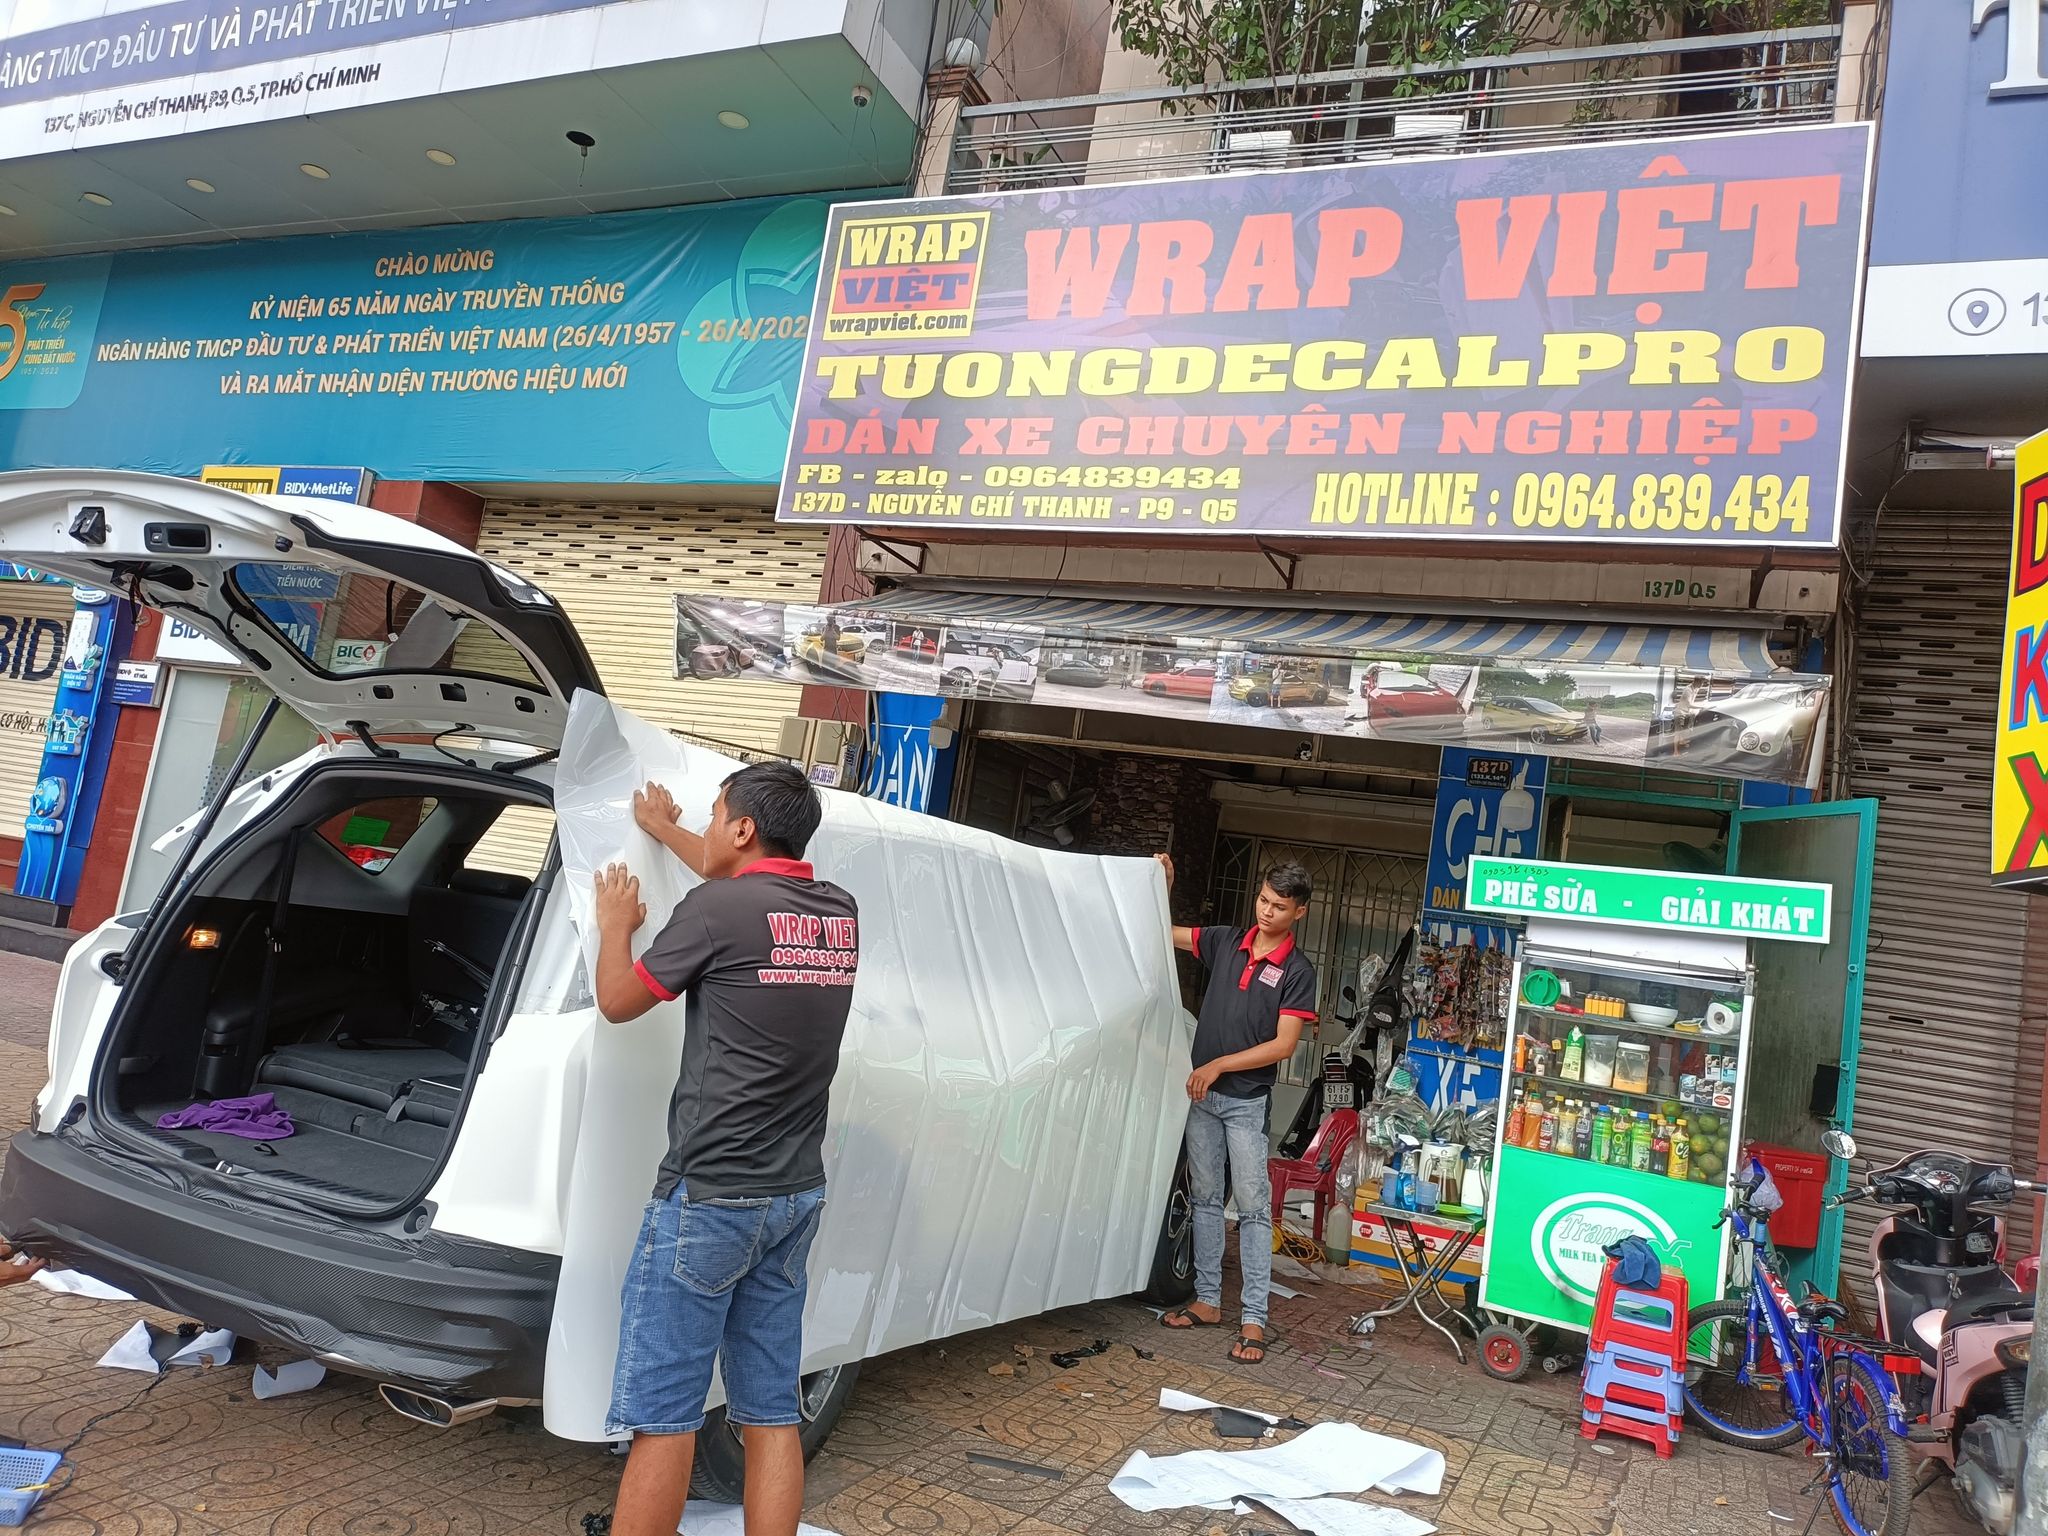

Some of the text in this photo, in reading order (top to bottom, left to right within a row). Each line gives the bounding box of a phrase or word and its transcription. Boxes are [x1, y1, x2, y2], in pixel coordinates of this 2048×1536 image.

[47, 38, 110, 80] TMCP
[112, 20, 165, 68] ĐẦU
[170, 13, 208, 58] TƯ
[210, 6, 241, 51] VÀ
[77, 99, 133, 128] NGUYỄN
[133, 96, 159, 119] CHÍ
[305, 66, 338, 92] CHÍ
[336, 63, 381, 88] MINH
[849, 221, 977, 266] WRAP
[1024, 155, 1842, 324] WRAP VIỆT
[374, 248, 494, 278] CHÀO MỪNG
[249, 276, 625, 321] KỶ NIỆM 65 NĂM NGÀY TRUYỀN THỐNG
[842, 268, 970, 310] VIỆT
[98, 339, 140, 362] NGÂN
[144, 336, 191, 361] HÀNG
[195, 337, 243, 358] TMCP
[246, 329, 284, 356] ĐẦU
[288, 334, 315, 355] TƯ
[314, 336, 328, 354] &
[332, 333, 384, 354] PHÁT
[389, 326, 444, 353] TRIỂN
[450, 323, 494, 354] VIỆT
[498, 326, 546, 350] NAM
[552, 320, 676, 352] (26/4/1957
[829, 312, 968, 335] wrapviet.com
[220, 361, 628, 398] VÀ RA MẮT NHẬN DIỆN THƯƠNG HIỆU MỚI
[816, 325, 1826, 399] TUONGDECALPRO
[802, 396, 1819, 466] DÁN XE CHUYÊN NGHIỆP
[797, 465, 843, 484] FB
[874, 466, 949, 488] zalo
[983, 466, 1242, 488] 0964839434
[792, 493, 846, 513] 137D
[867, 487, 963, 516] NGUYỄN
[970, 491, 1014, 516] CHÍ
[1022, 496, 1112, 518] THANH
[1138, 498, 1175, 520] P9
[1200, 499, 1238, 523] Q5
[1311, 472, 1479, 525] HOTLINE
[1512, 471, 1811, 533] 0964.839.434
[1644, 579, 1686, 598] 137D
[170, 618, 208, 640] BID
[1471, 760, 1509, 774] 137D
[1484, 876, 1538, 908] PHÊ
[1544, 877, 1598, 914] SỮA
[1661, 887, 1720, 926] GIẢI
[1730, 896, 1815, 933] KHÁT
[767, 912, 857, 949] WRAP VIET
[770, 947, 858, 968] 0964839434
[1675, 1142, 1689, 1159] C2
[1360, 1227, 1373, 1235] STOP
[1559, 1247, 1579, 1260] MILK
[1582, 1251, 1597, 1263] TEA
